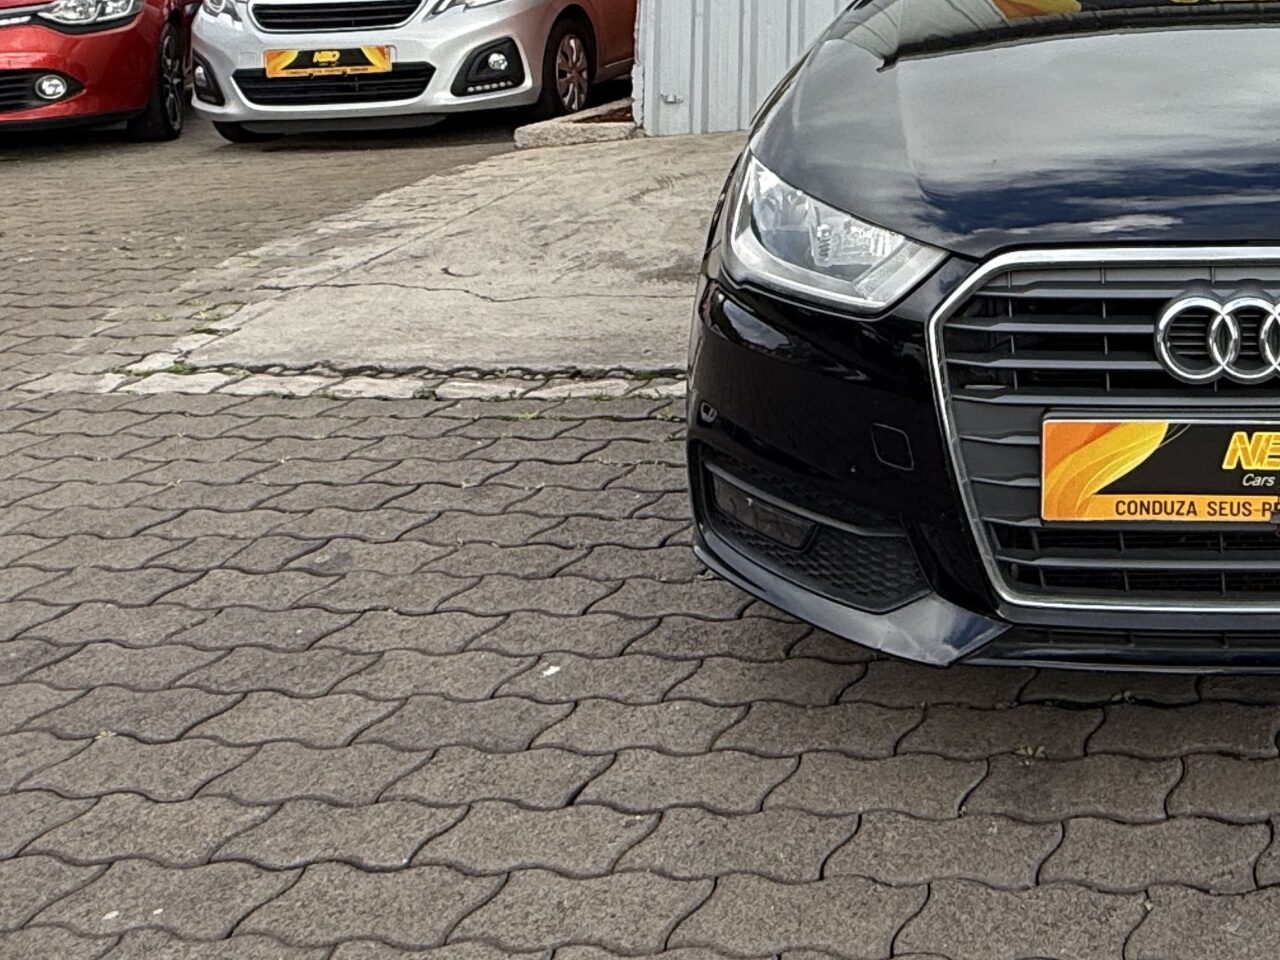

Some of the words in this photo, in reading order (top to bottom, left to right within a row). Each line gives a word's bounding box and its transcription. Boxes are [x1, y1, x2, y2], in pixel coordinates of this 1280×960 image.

[1242, 473, 1276, 487] Cars
[1114, 499, 1197, 516] CONDUZA
[1206, 501, 1252, 517] SEUS
